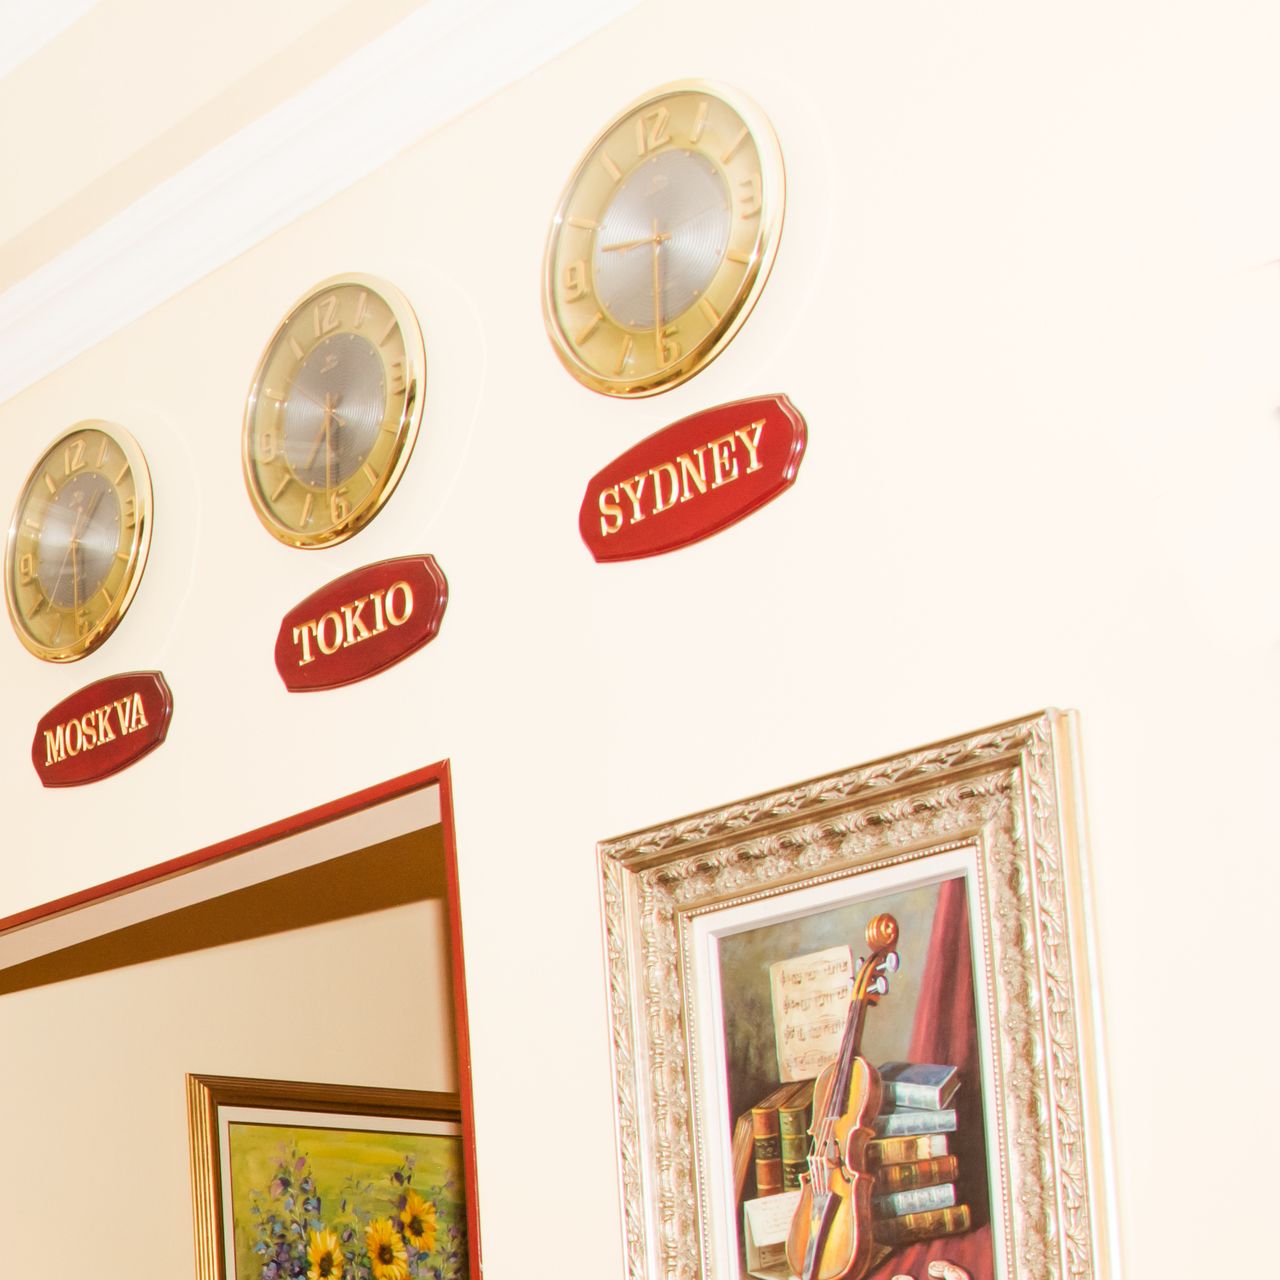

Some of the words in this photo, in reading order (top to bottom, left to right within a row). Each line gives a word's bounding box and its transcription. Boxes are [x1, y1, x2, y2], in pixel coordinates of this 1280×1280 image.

[636, 106, 672, 157] 12
[562, 260, 587, 304] 9
[313, 295, 342, 339] 12
[63, 438, 87, 477] 12
[597, 417, 768, 538] SYDNEY
[292, 580, 415, 667] TOKIO
[43, 690, 150, 768] MOSKVA
